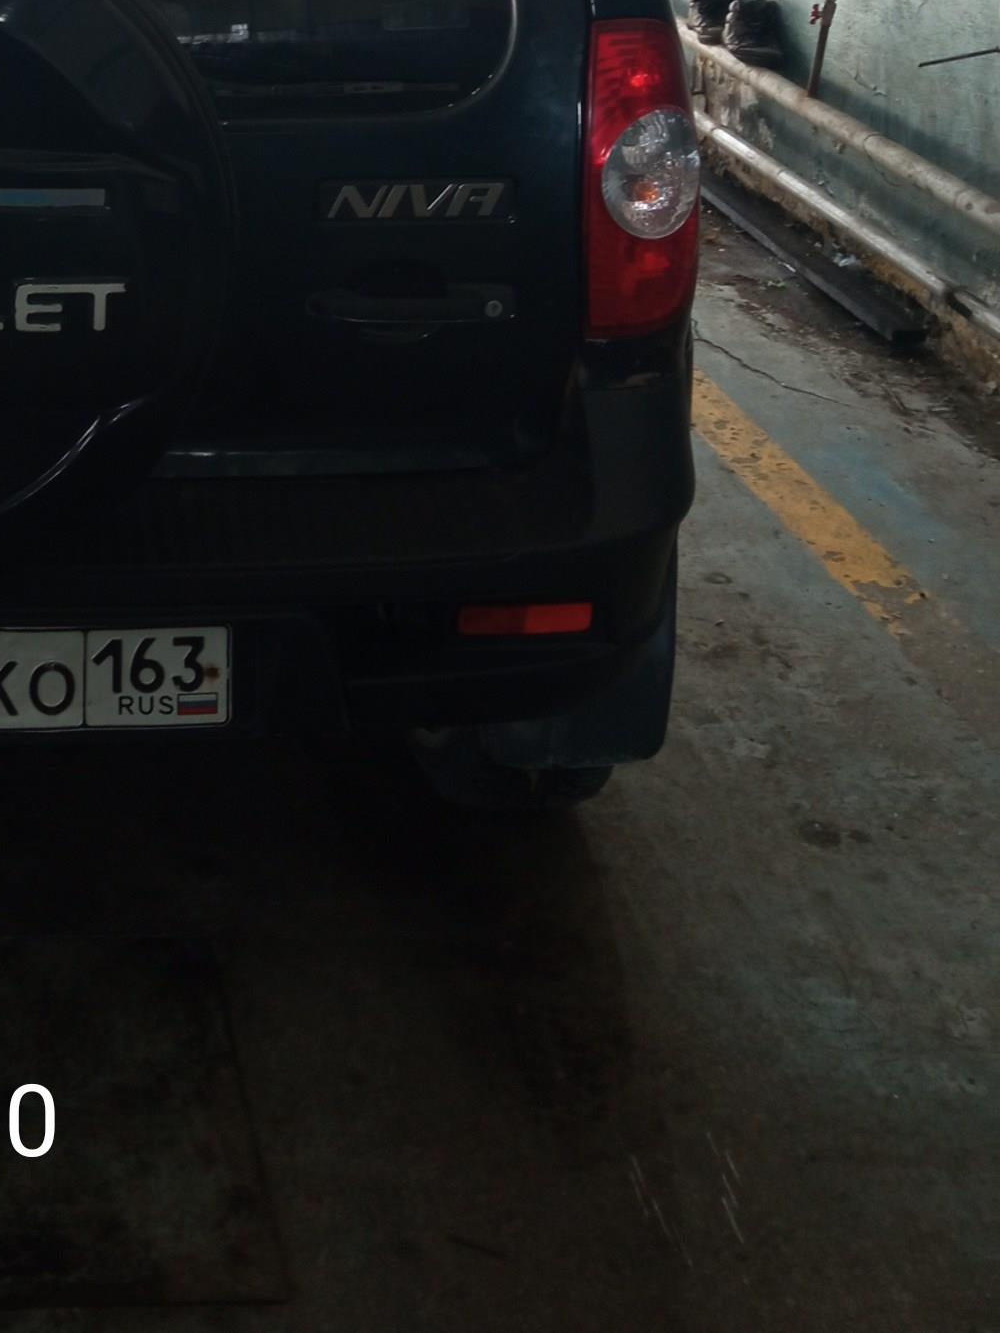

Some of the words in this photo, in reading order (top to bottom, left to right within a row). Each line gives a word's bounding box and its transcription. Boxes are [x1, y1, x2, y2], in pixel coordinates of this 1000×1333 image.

[326, 182, 505, 219] NIVA
[92, 636, 205, 694] 163
[118, 695, 174, 716] RUS
